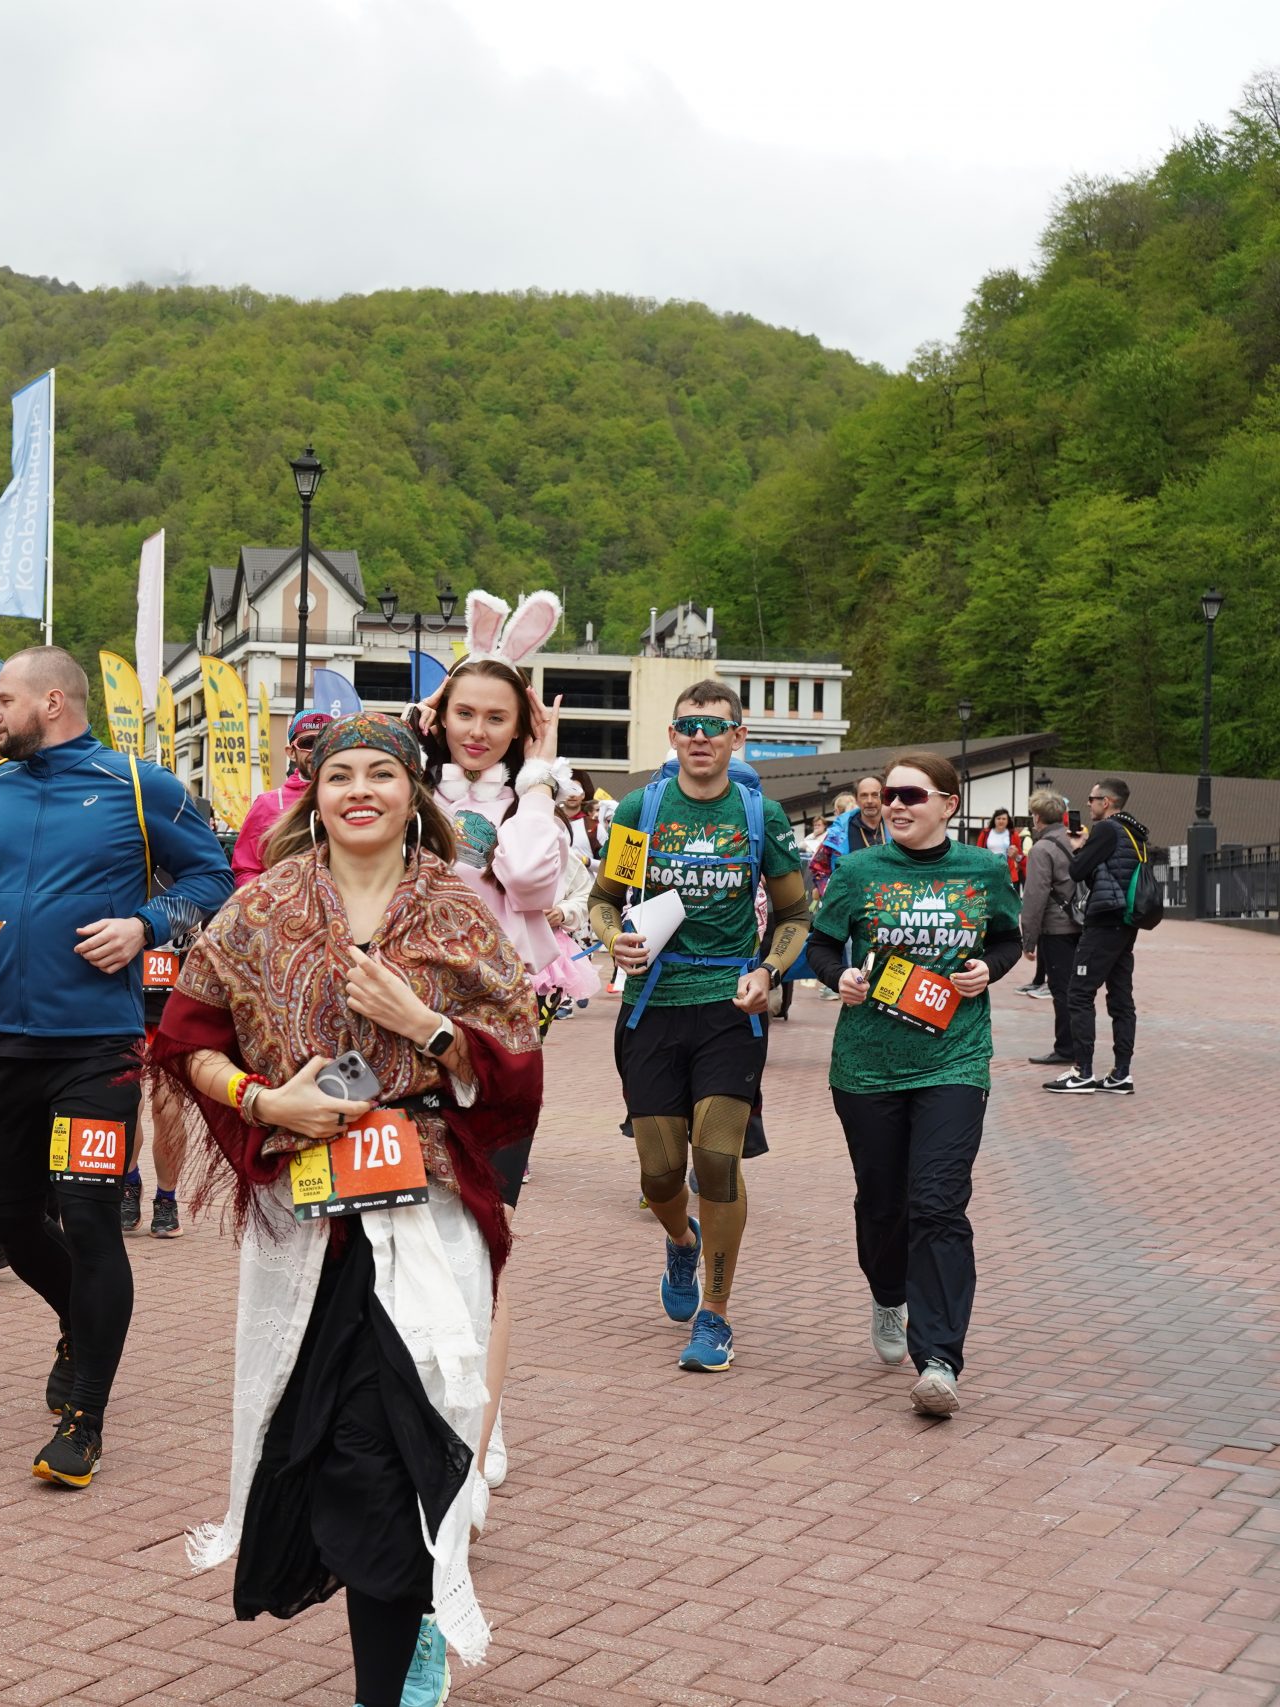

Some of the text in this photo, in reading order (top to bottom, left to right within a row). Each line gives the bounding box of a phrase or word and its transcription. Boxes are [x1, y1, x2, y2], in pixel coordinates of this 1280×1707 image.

[619, 844, 641, 869] ROSA
[615, 865, 635, 880] RUN
[650, 865, 743, 889] ROSA RUN
[680, 887, 709, 897] 2023
[900, 911, 956, 927] МИР
[877, 927, 978, 948] ROSA RUN
[910, 946, 940, 956] 2023
[148, 957, 172, 975] 284
[880, 986, 895, 996] ROSA
[915, 978, 951, 1012] 556
[81, 1129, 116, 1158] 220
[347, 1124, 401, 1171] 726
[79, 1161, 116, 1170] VLADIMIR
[298, 1177, 323, 1188] ROSA
[396, 1194, 414, 1204] AVA
